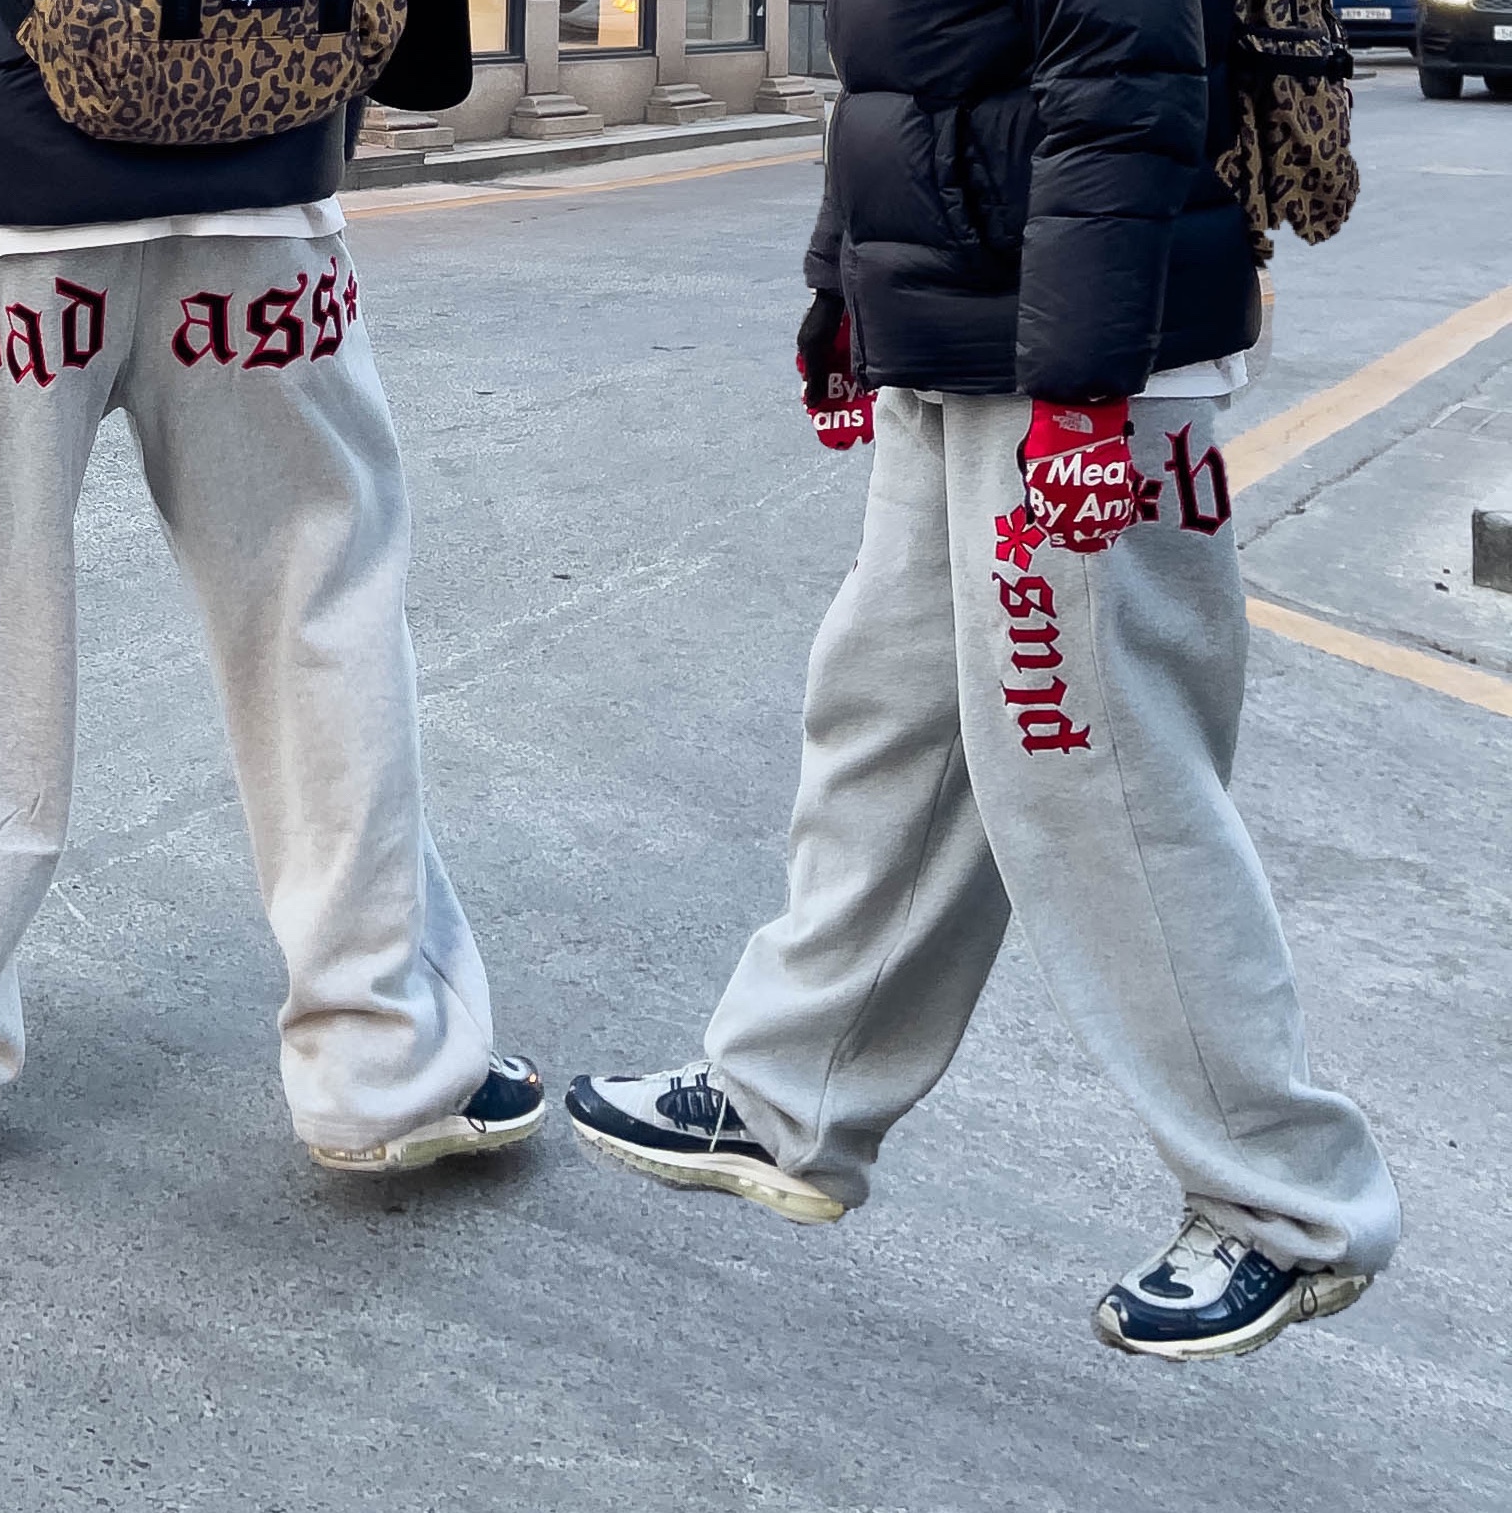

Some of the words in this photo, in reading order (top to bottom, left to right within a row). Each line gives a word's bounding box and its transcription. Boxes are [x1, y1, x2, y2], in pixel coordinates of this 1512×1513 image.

[172, 255, 347, 370] ass
[809, 409, 864, 431] ans
[827, 372, 858, 403] By
[1029, 487, 1067, 528] By
[1164, 420, 1231, 536] b
[992, 571, 1092, 756] plus
